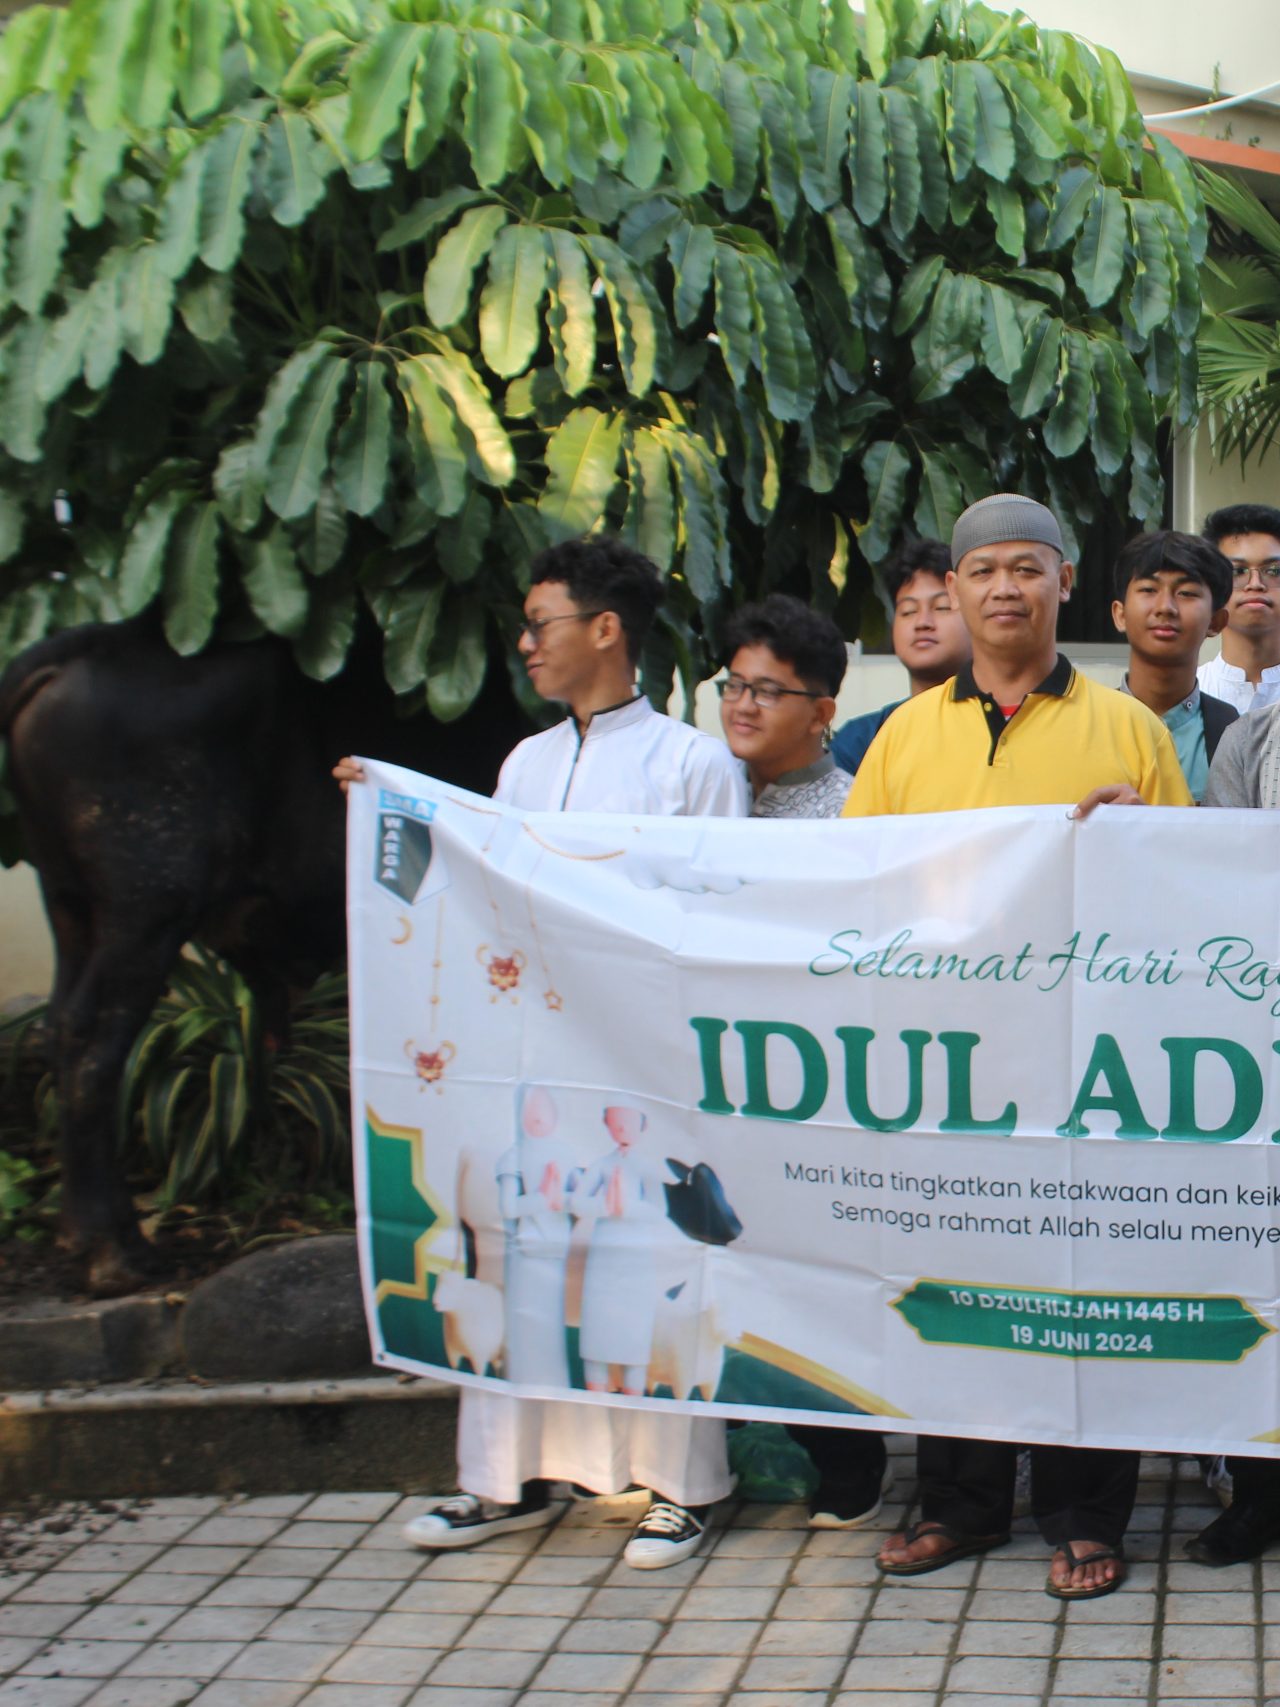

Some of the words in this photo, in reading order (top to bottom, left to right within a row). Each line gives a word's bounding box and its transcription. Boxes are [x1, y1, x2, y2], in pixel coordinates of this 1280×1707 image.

[382, 816, 403, 880] WARGA
[808, 929, 1035, 983] Selamat
[1038, 931, 1182, 993] Hari
[690, 1016, 1018, 1138] IDUL
[785, 1162, 835, 1186] Mari
[841, 1167, 884, 1189] kita
[891, 1170, 1022, 1200] tingkatkan
[1030, 1178, 1169, 1204] ketakwaan
[1176, 1181, 1229, 1206] dan
[831, 1200, 931, 1233] Semoga
[938, 1210, 1032, 1235] rahmat
[1039, 1214, 1101, 1239] Allah
[1108, 1217, 1183, 1242] selalu
[949, 1290, 974, 1306] 10
[977, 1293, 1120, 1320] DZULHIJJAH
[1125, 1301, 1182, 1322] 1445
[1187, 1302, 1205, 1322] H
[1010, 1324, 1034, 1344] 19
[1038, 1329, 1090, 1350] JUNI
[1095, 1333, 1154, 1352] 2024
